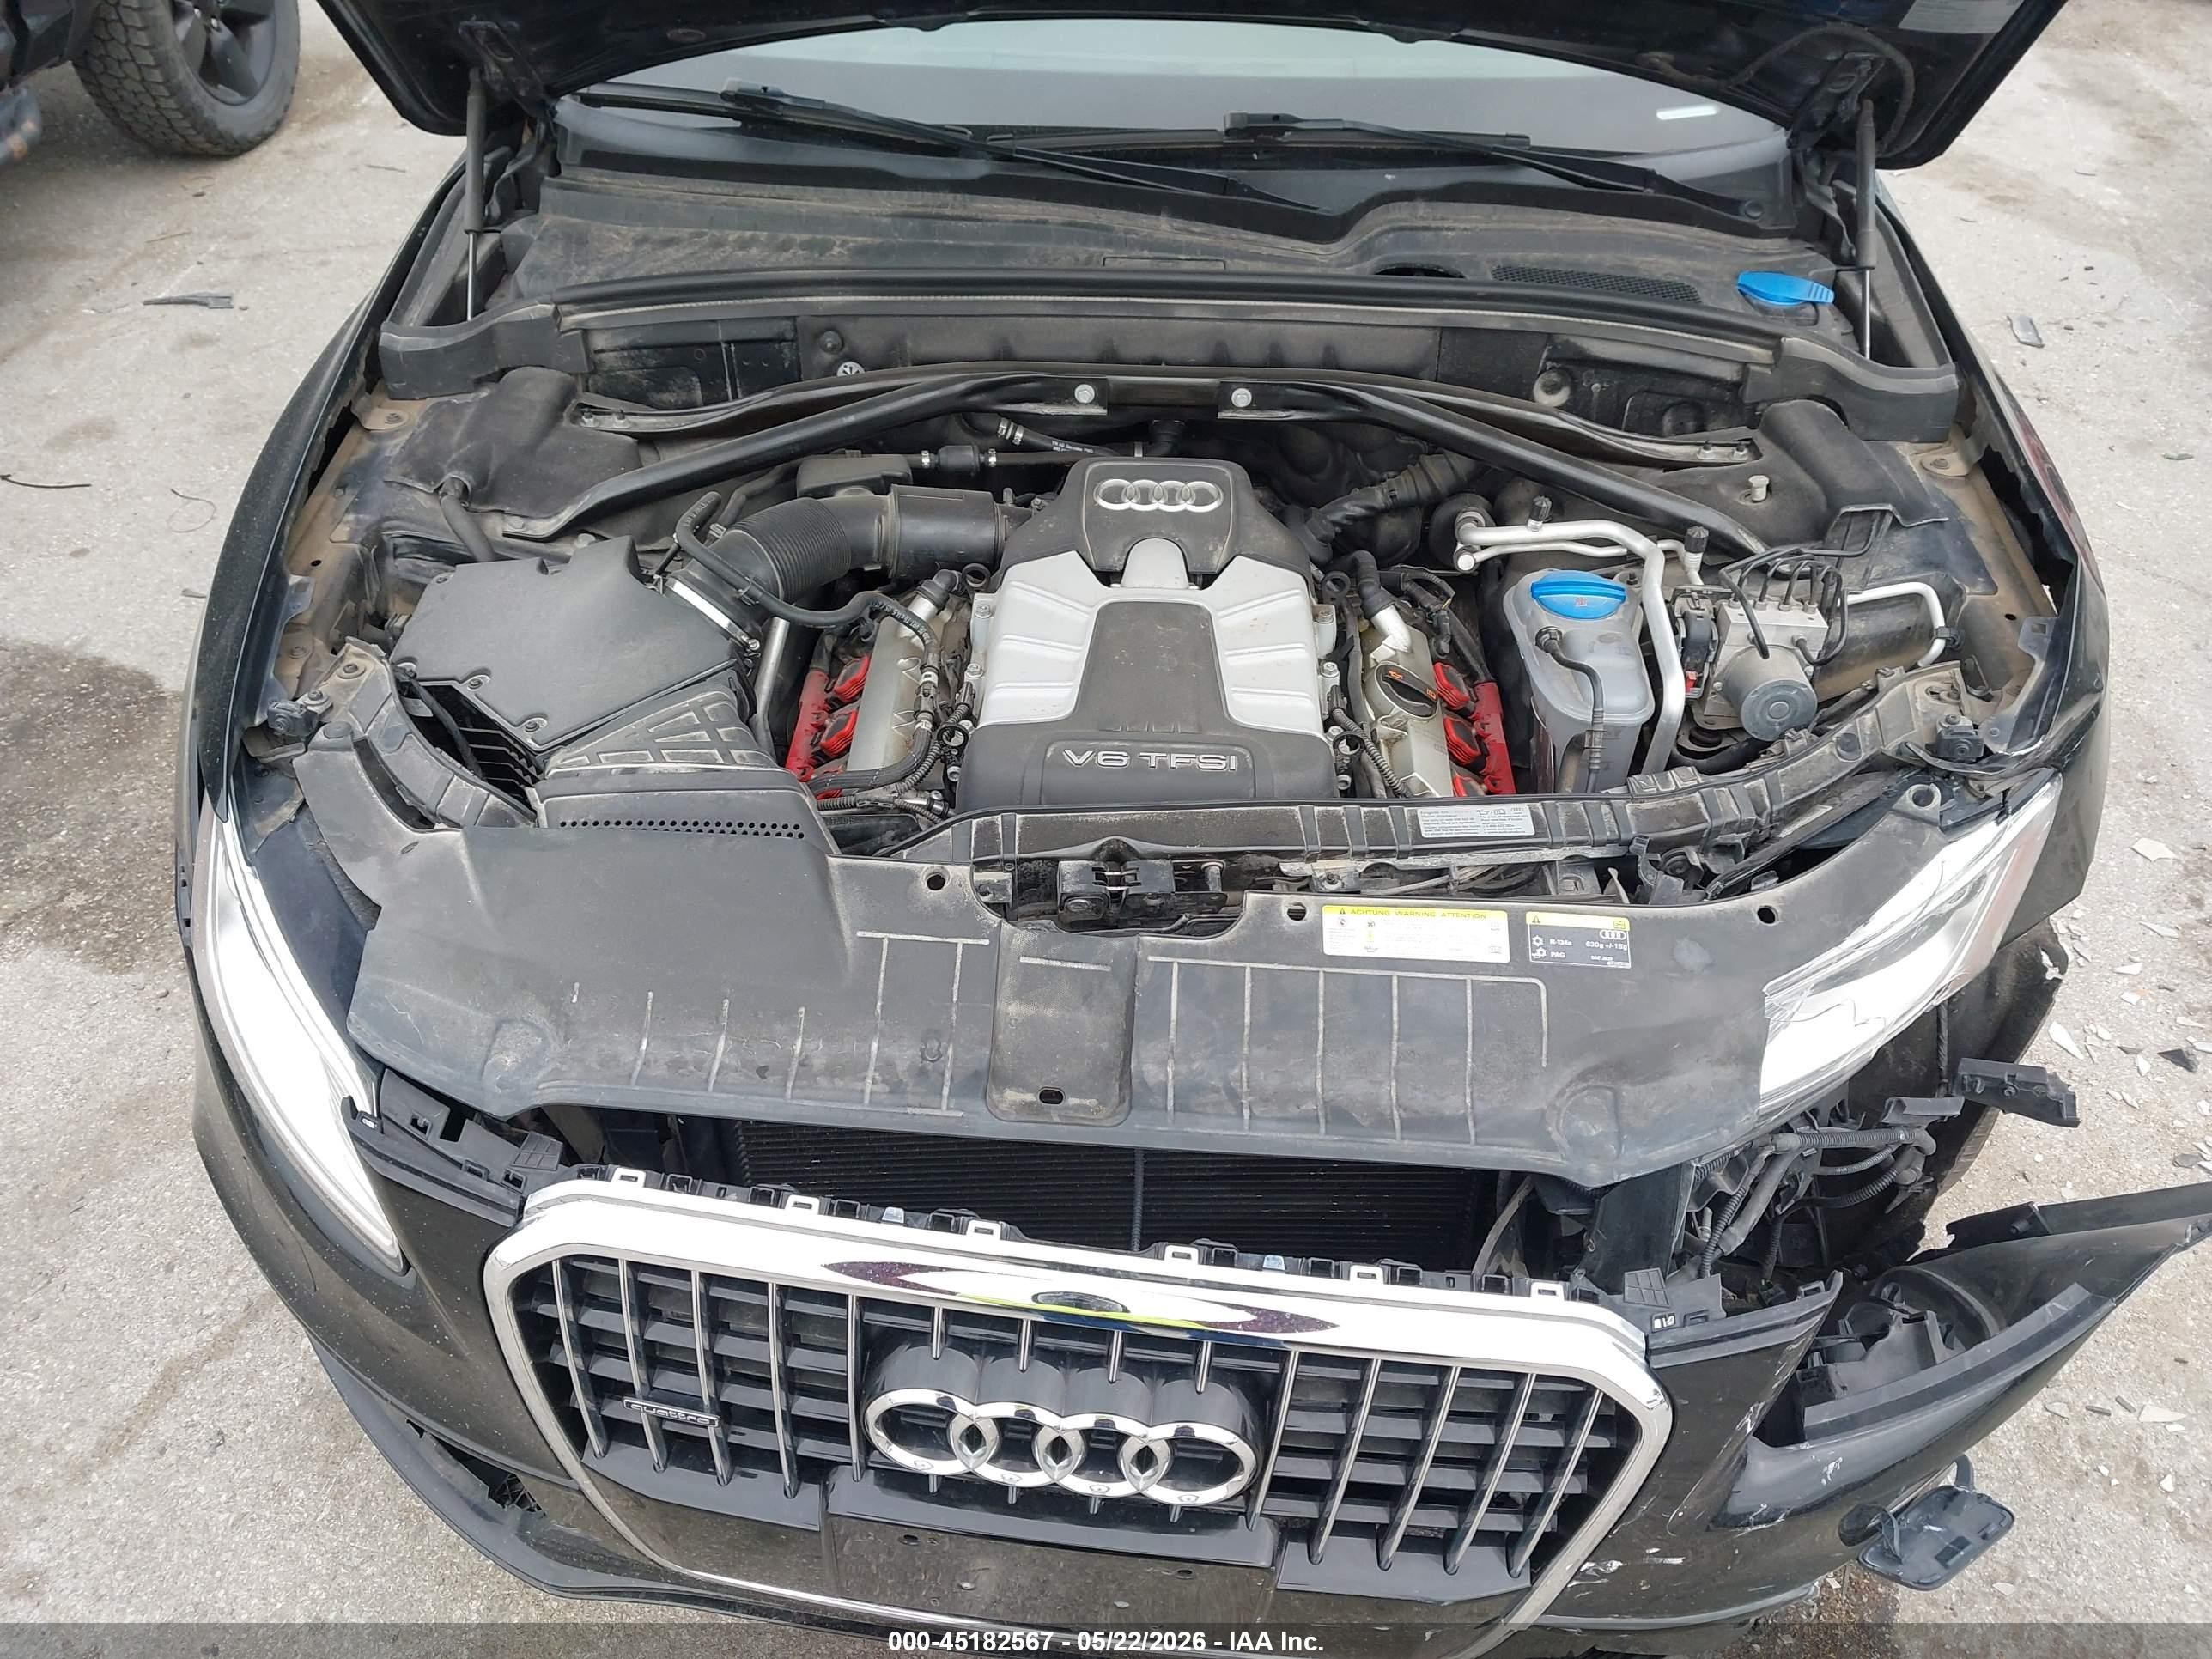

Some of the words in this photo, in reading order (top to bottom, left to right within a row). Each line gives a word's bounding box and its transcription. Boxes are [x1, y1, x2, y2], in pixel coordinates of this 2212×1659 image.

[1063, 750, 1131, 769] V6
[1139, 751, 1237, 772] TFSI
[1585, 940, 1604, 949] 630g
[1550, 951, 1566, 959] PAG
[630, 1403, 710, 1425] quattro
